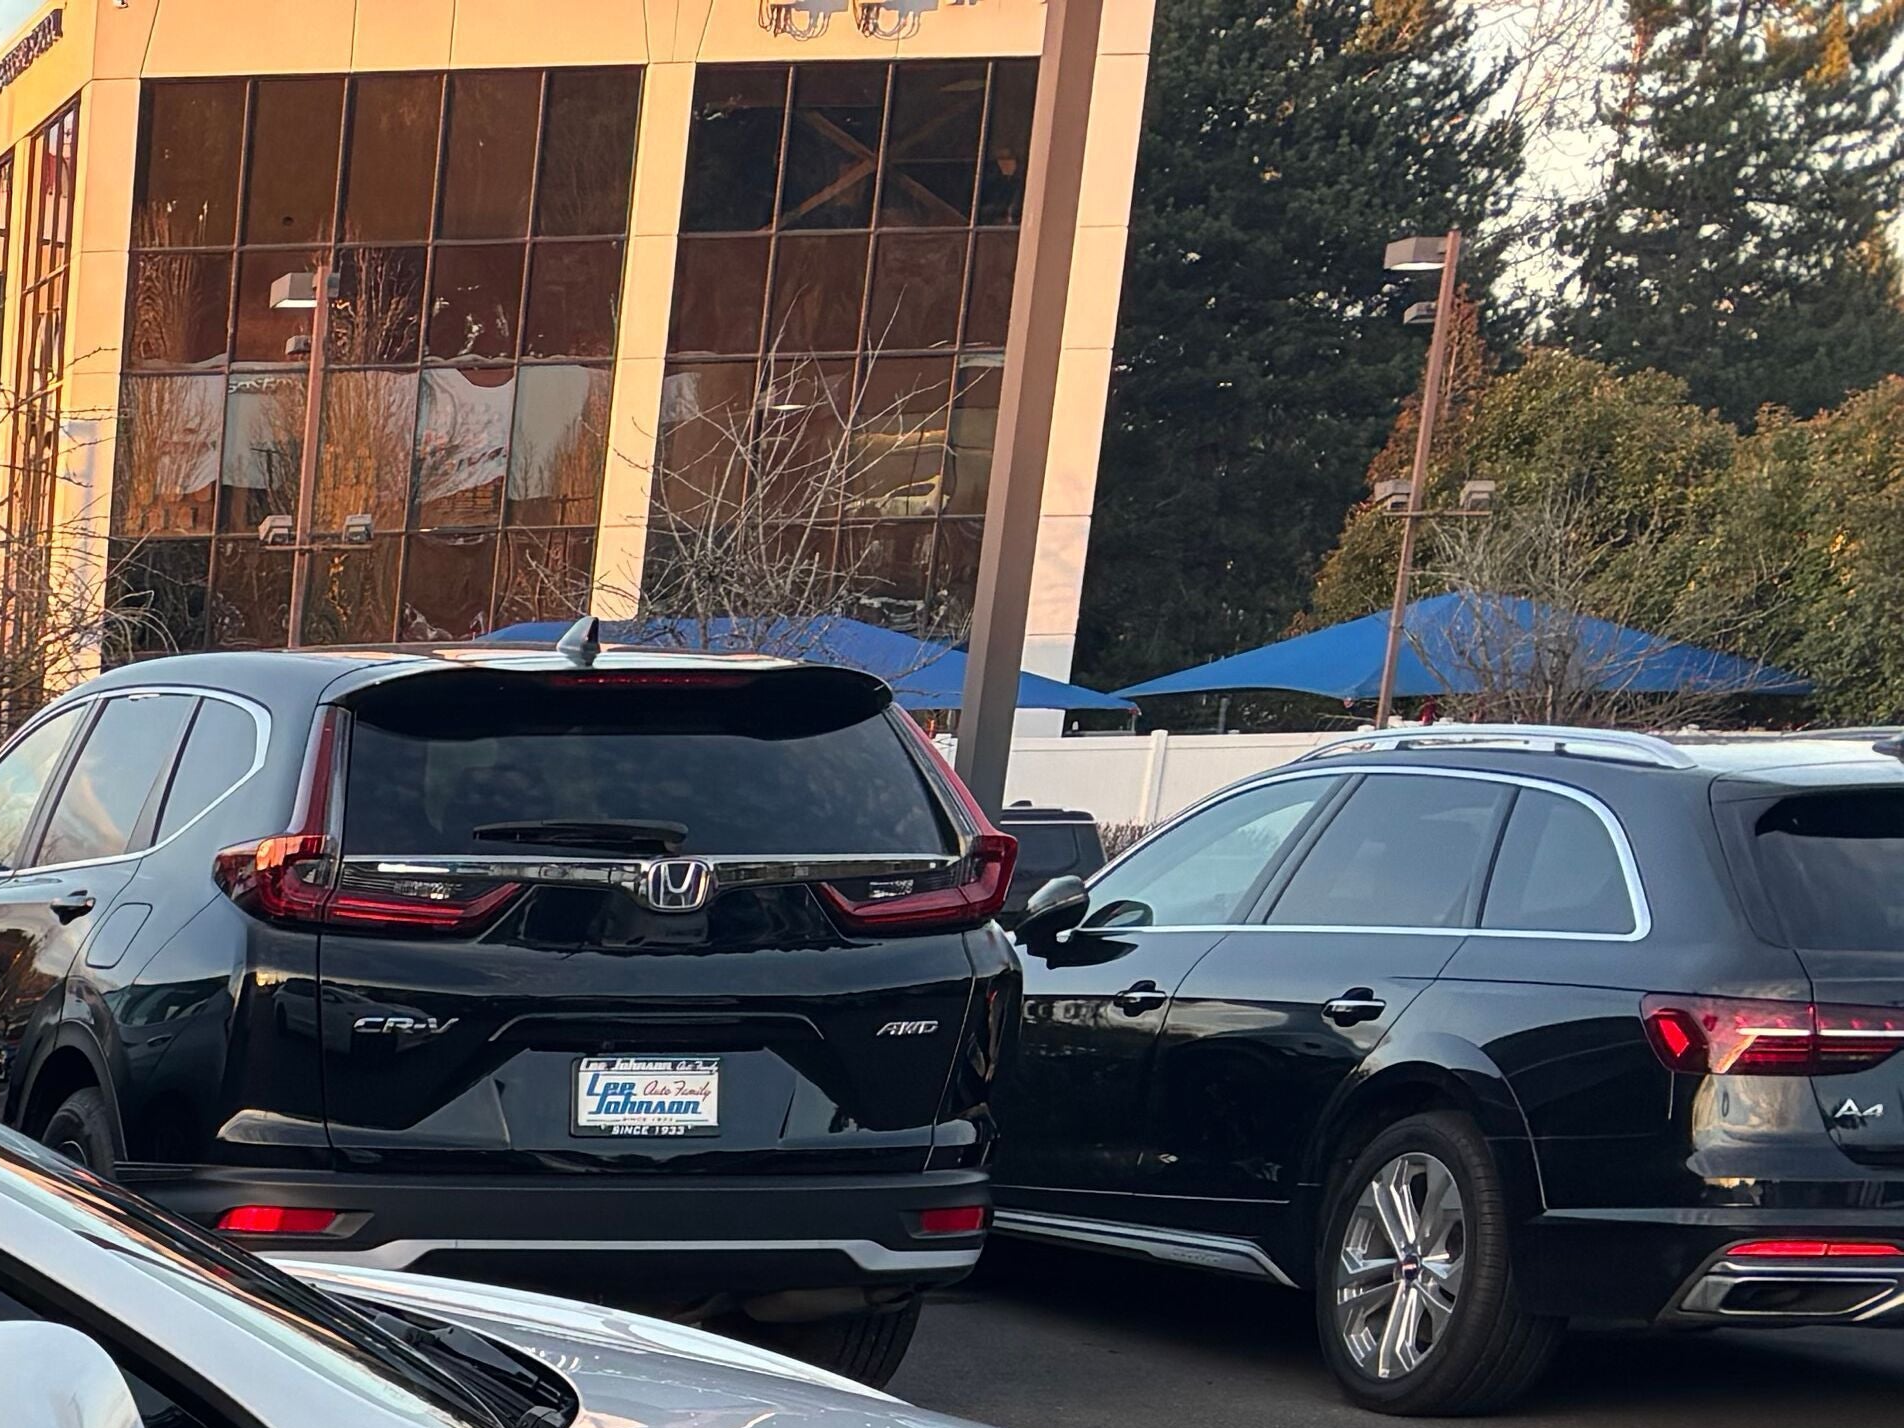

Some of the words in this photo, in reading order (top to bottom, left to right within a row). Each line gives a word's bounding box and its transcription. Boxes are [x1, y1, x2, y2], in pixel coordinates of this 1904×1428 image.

[353, 1017, 460, 1033] CR-V
[876, 1020, 938, 1036] AWD
[612, 1058, 672, 1071] Johnson
[586, 1073, 636, 1096] Lee
[643, 1080, 672, 1096] Auto
[673, 1080, 712, 1102] Family
[588, 1090, 702, 1114] Johnson
[1834, 1098, 1884, 1118] A4
[611, 1126, 649, 1135] SINCE
[655, 1125, 685, 1135] 1933
